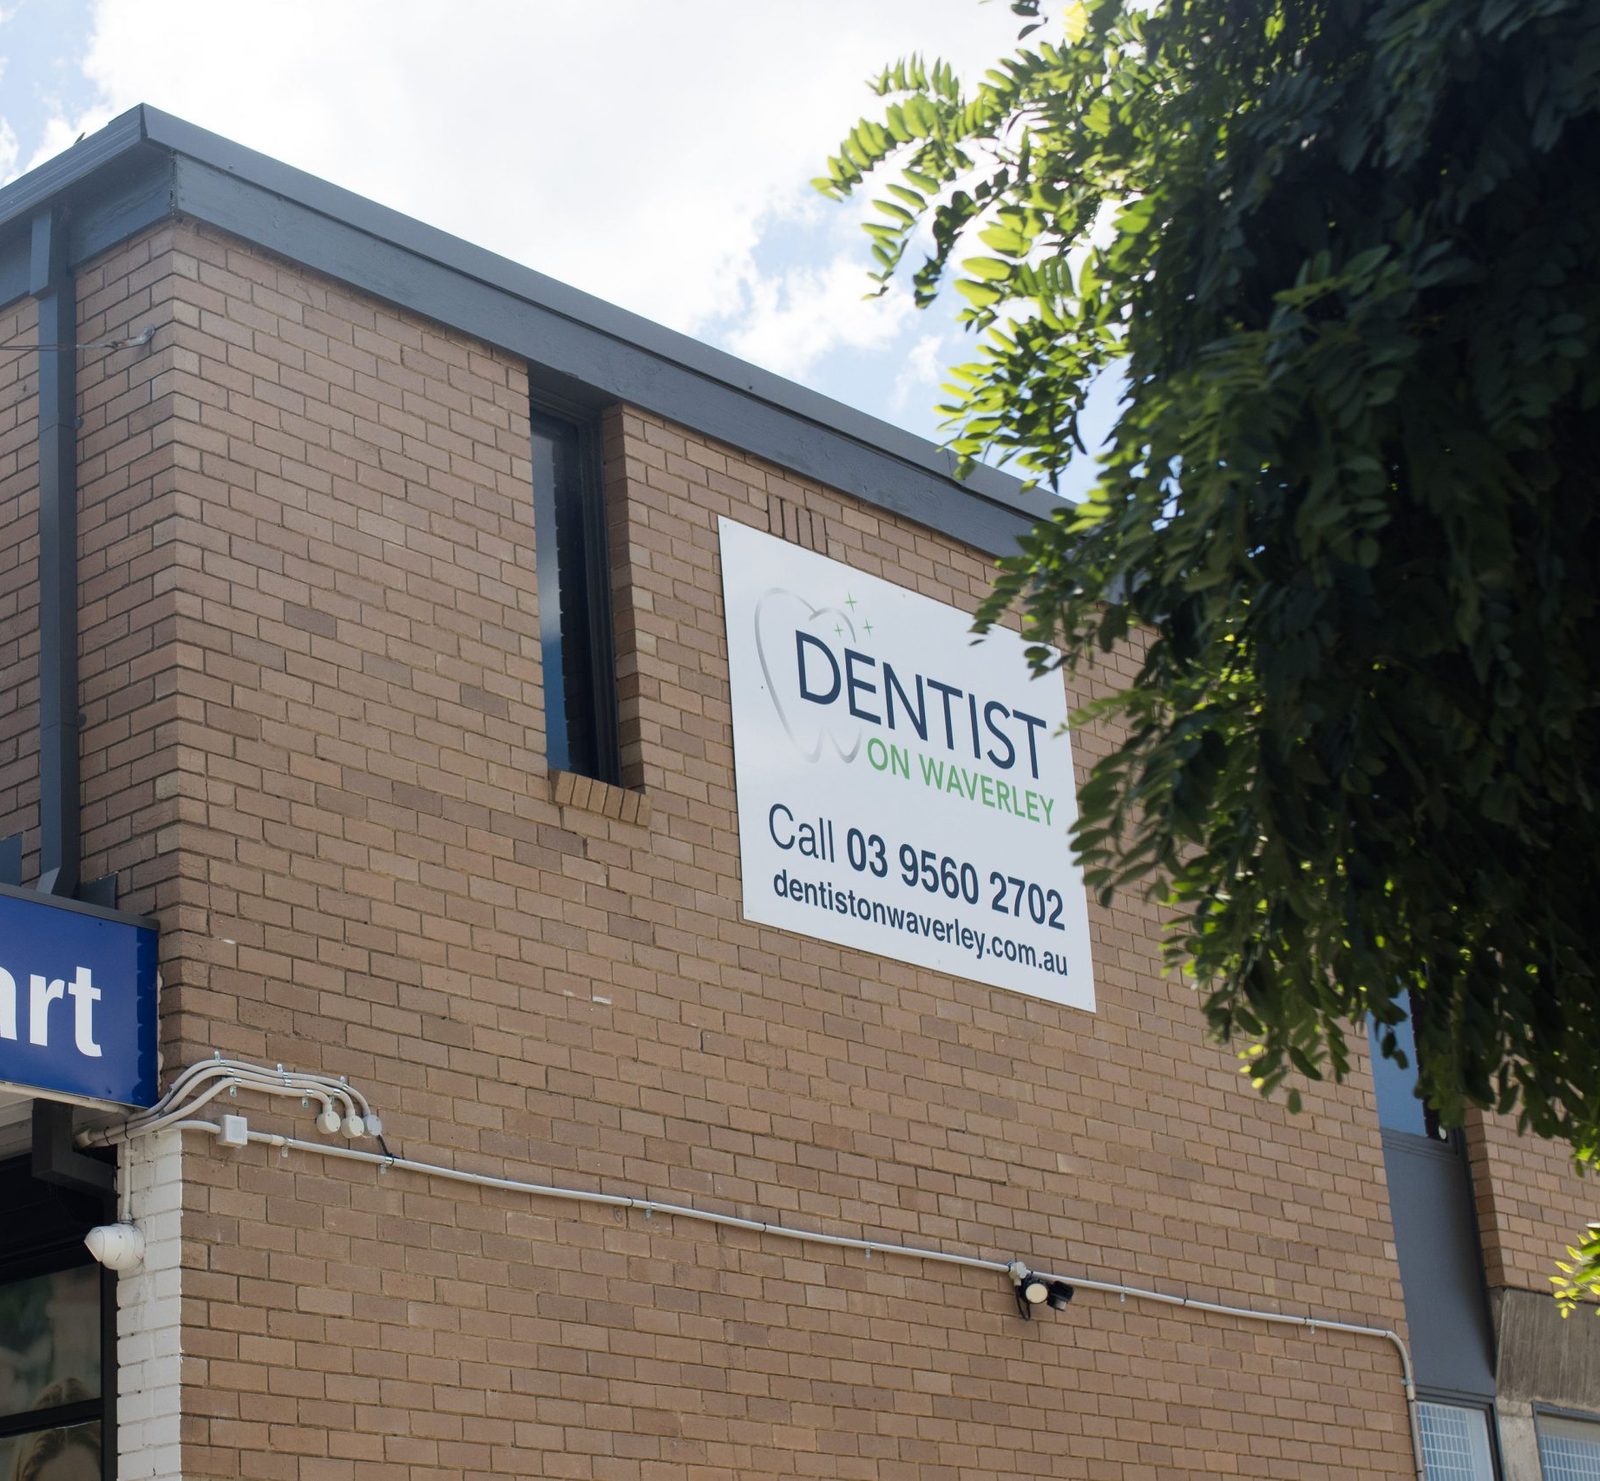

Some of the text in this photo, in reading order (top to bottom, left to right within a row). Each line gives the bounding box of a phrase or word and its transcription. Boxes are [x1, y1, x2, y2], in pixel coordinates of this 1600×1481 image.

[796, 630, 1047, 780] DENTIST
[867, 737, 1055, 826] ON WAVERLEY
[768, 803, 1066, 931] Call 03 9560 2702
[773, 868, 1068, 977] dentistonwaverley.com.au
